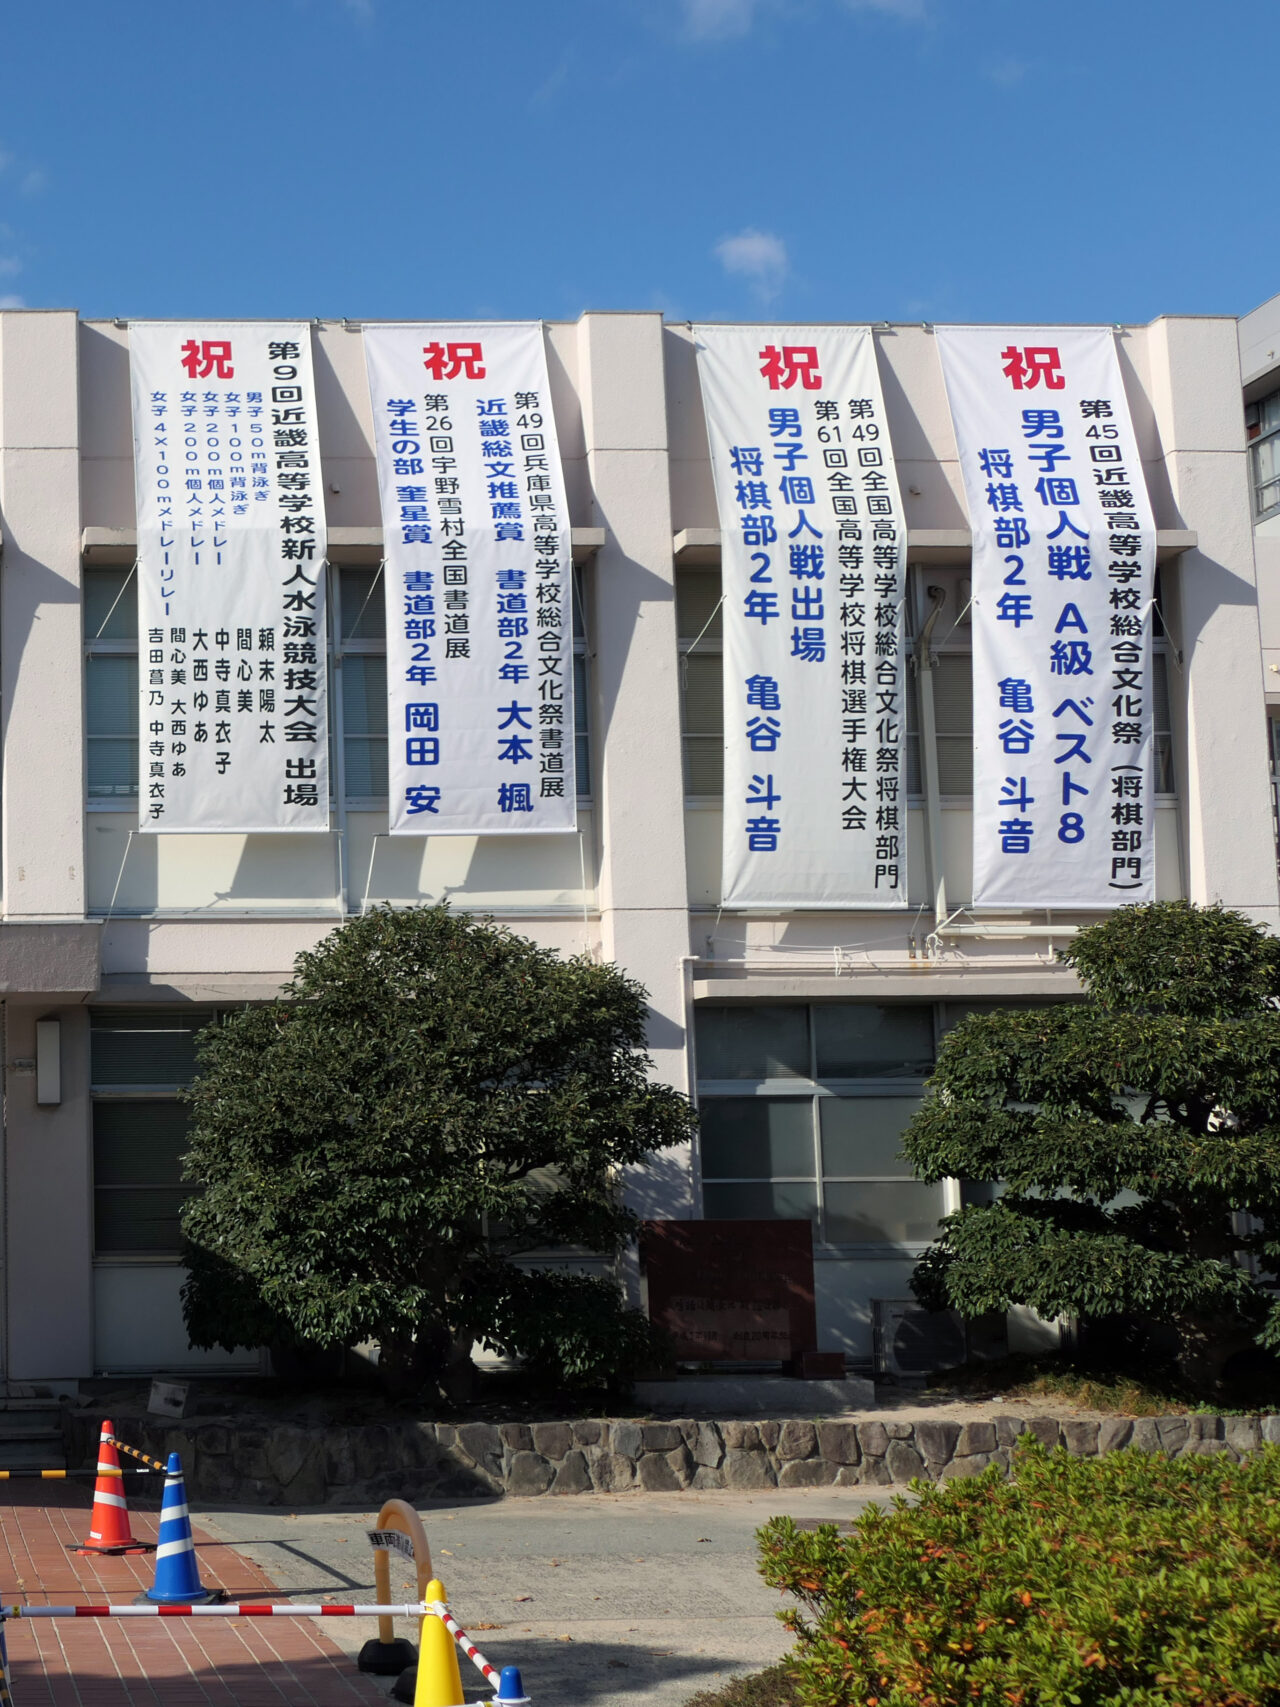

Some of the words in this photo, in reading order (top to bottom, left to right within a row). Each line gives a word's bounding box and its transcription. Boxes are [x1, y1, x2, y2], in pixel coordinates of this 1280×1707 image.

[181, 340, 234, 379] 祝
[423, 342, 486, 381] 祝
[759, 345, 822, 391] 祝
[1000, 346, 1065, 391] 祝
[386, 399, 426, 476] 学生の部
[476, 399, 526, 543] 近畿総文推薦賞
[396, 486, 433, 545] 奎星賞
[424, 394, 472, 660] 第26回宇野雪村全国書道展
[1021, 410, 1092, 582] 男子個人戦
[268, 341, 318, 744] 第9回近畿高等学校新人水泳競技大会
[730, 447, 781, 626] 将棋部2年
[767, 408, 827, 663] 男子個人戦出場
[977, 448, 1034, 628] 将棋部2年
[404, 571, 438, 686] 書道部2年
[496, 569, 531, 685] 書道部2年
[514, 391, 566, 798] 第49回兵庫県高等学校総合文化祭書道展
[814, 401, 868, 831] 第61回全国高等学校将棋選手権大会
[848, 399, 901, 890] 第49回全国高等学校総合文化祭将棋部門
[1050, 603, 1094, 677] A級
[405, 703, 440, 766] 岡田
[496, 701, 534, 764] 大本
[745, 675, 782, 753] 亀谷
[997, 677, 1035, 755] 亀谷
[283, 759, 319, 806] 出場
[406, 786, 441, 815] 安
[497, 783, 534, 813] 楓
[1052, 698, 1094, 844] ベスト8
[745, 775, 782, 853] 斗音
[998, 777, 1035, 854] 斗音
